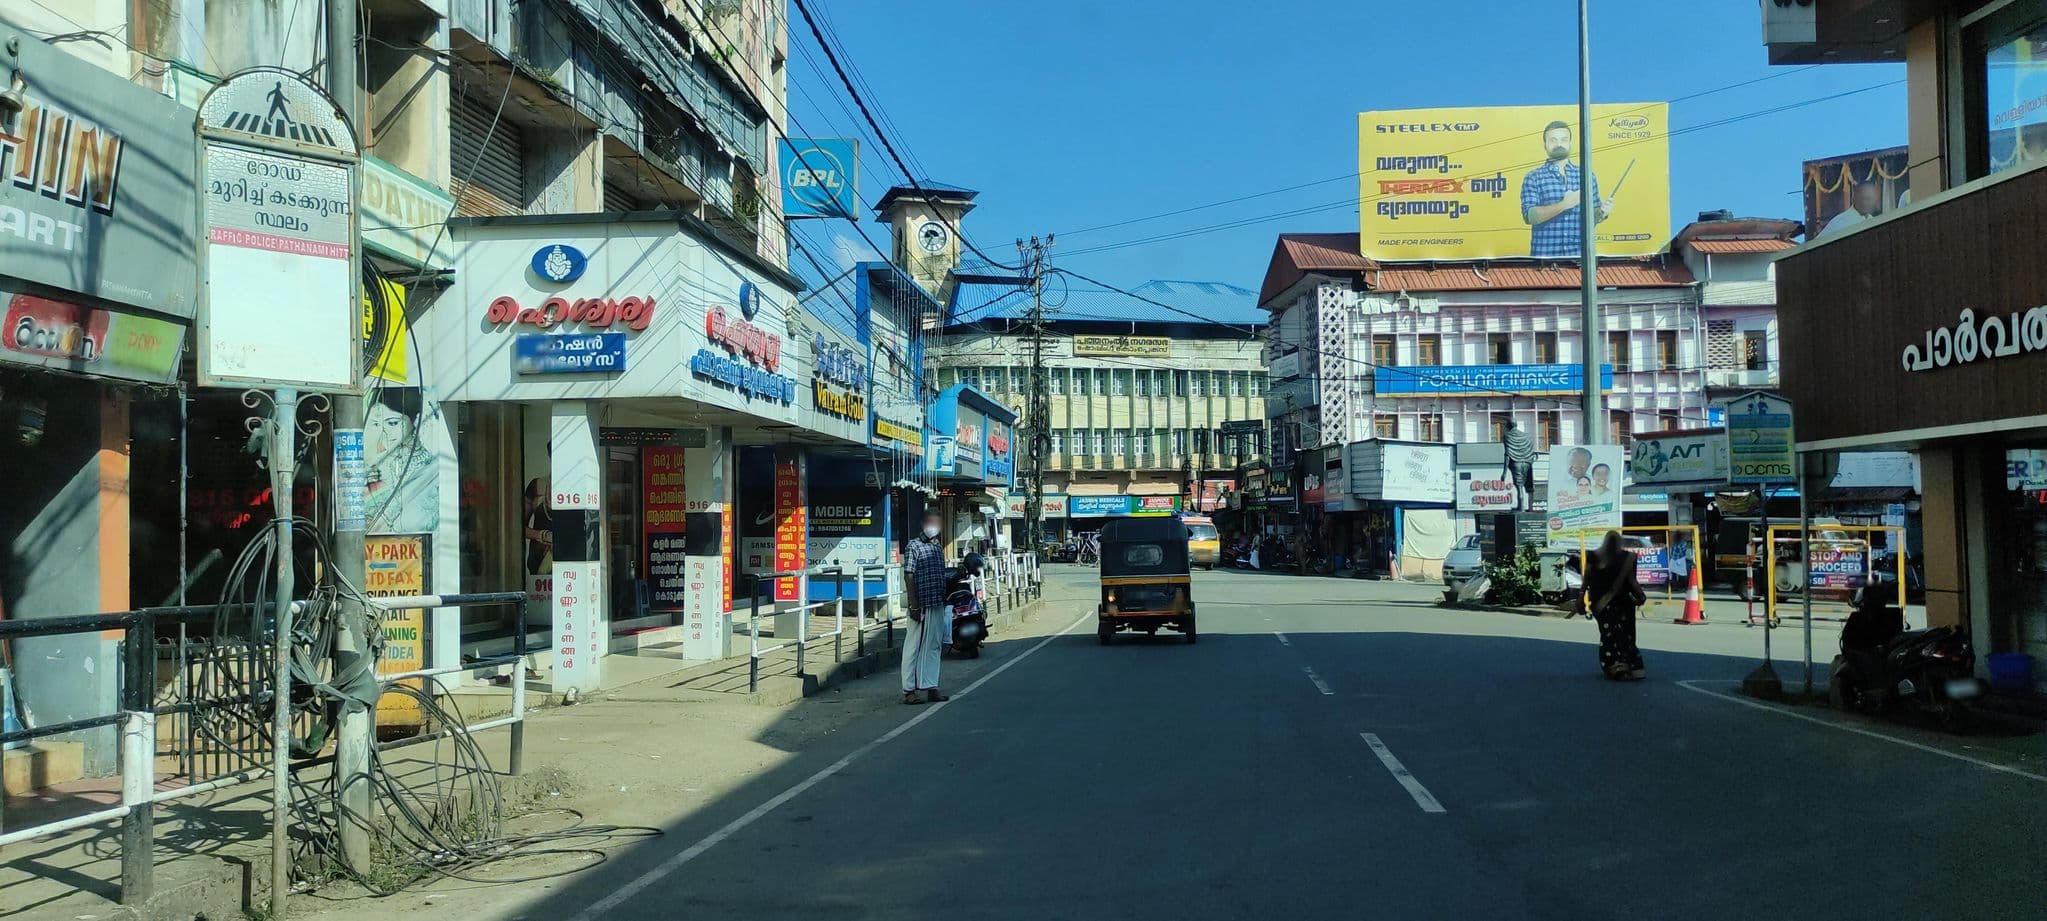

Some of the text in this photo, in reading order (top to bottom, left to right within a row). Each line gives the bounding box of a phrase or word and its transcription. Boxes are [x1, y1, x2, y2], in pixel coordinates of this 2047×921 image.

[1376, 123, 1475, 133] STEELEX TMT
[247, 160, 306, 181] റോഡ്
[1376, 155, 1462, 174] വരുന്നു...
[793, 168, 840, 188] BPL
[1377, 179, 1464, 194] THERMEX
[211, 178, 350, 217] മുറിച്ച് കടക്കുന്ന
[1377, 200, 1469, 219] ഭദ്രതയും
[255, 211, 309, 232] സ്ഥലം
[245, 234, 276, 248] POLICE
[487, 296, 656, 331] ഐശ്വര്യ
[1501, 372, 1568, 386] FINANCE
[1670, 443, 1705, 459] AVT
[557, 494, 580, 504] 916
[689, 501, 708, 509] 916
[815, 506, 872, 517] MOBILES
[382, 543, 418, 560] PARK
[751, 541, 776, 549] SAMSU
[1810, 551, 1863, 561] STOP AND
[1811, 562, 1862, 572] PROCEED
[365, 571, 415, 586] TD FAX
[388, 646, 414, 660] IDEA
